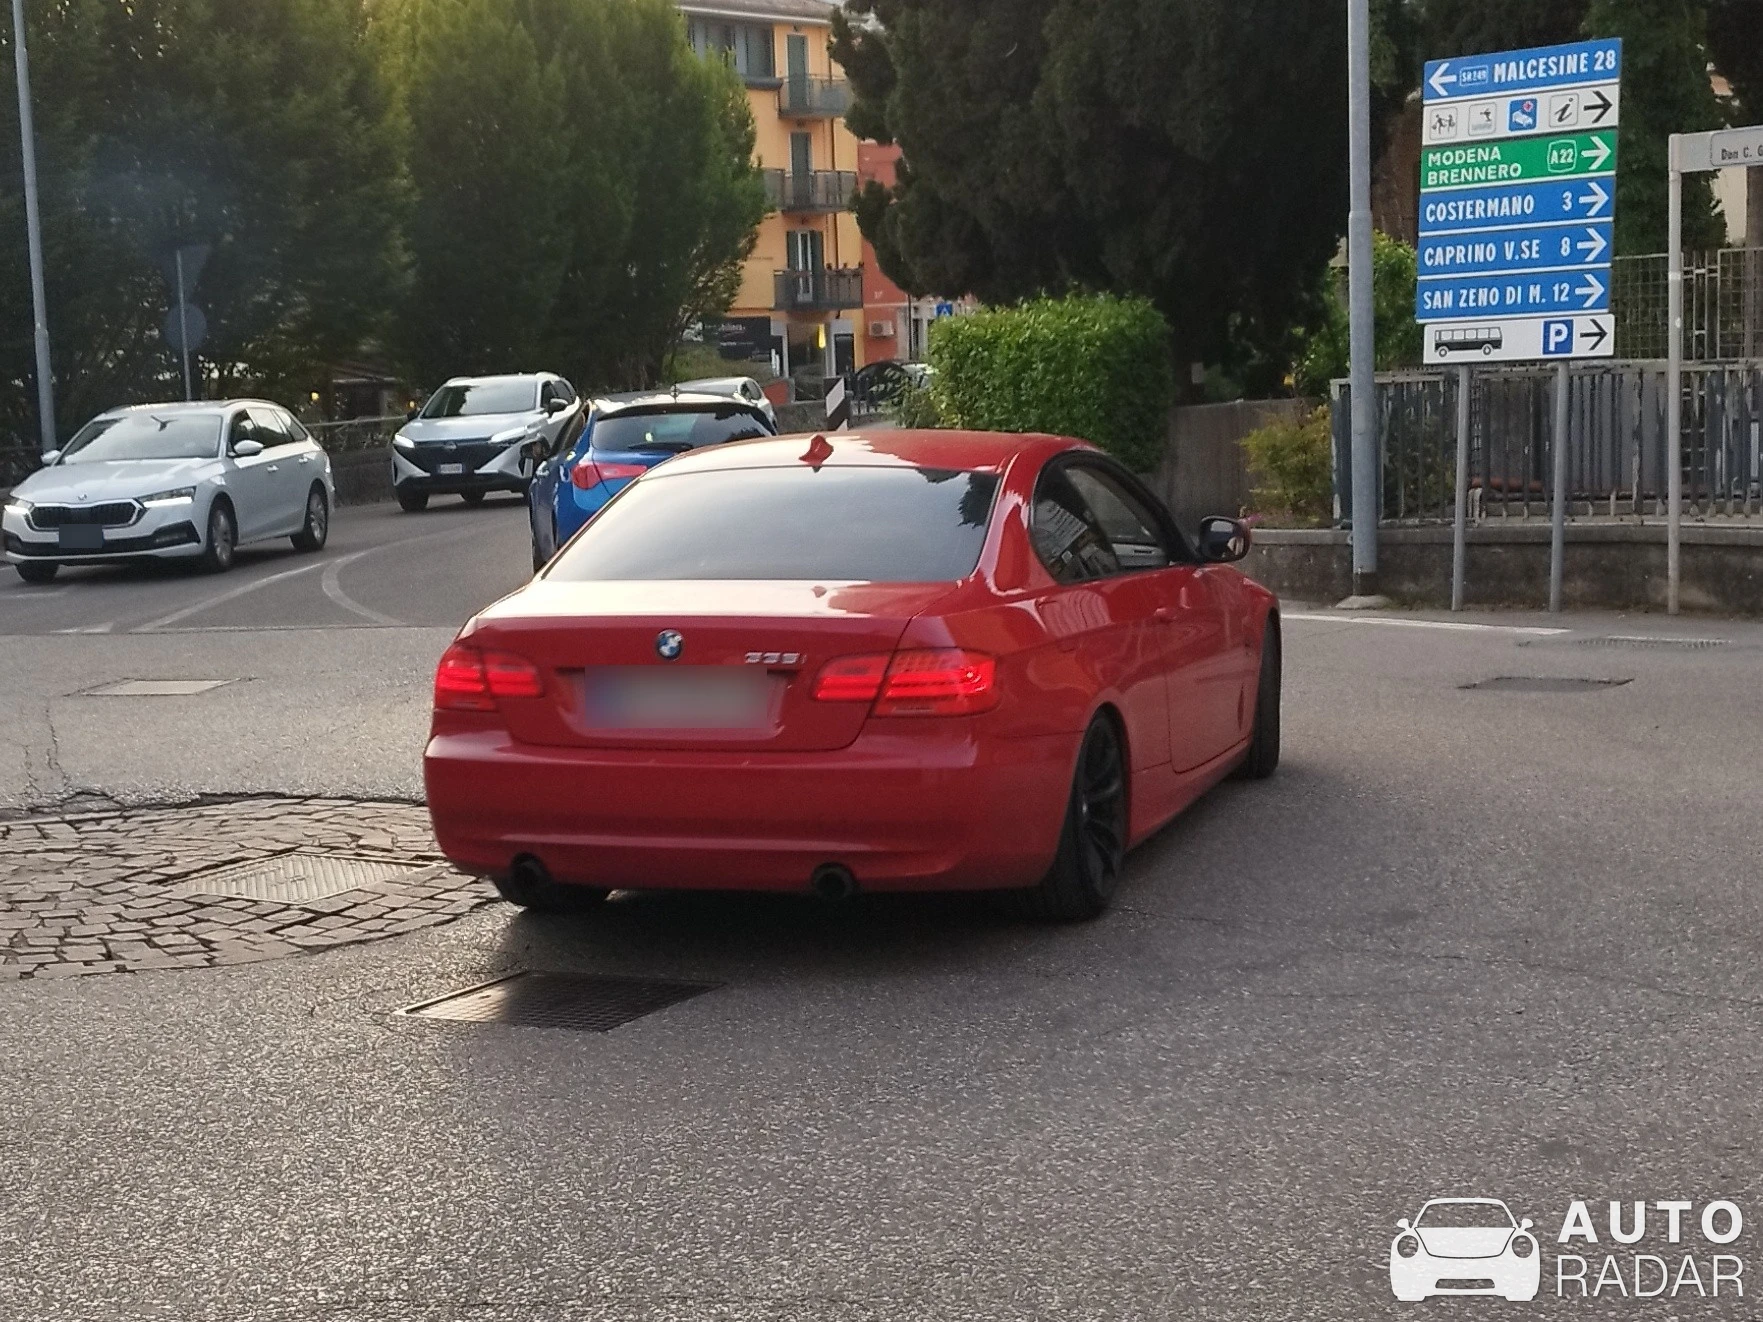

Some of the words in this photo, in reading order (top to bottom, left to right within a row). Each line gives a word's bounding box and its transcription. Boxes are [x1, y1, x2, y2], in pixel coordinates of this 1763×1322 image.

[1493, 53, 1588, 83] MALCESINE
[1594, 49, 1616, 71] 28
[1427, 146, 1501, 167] MODENA
[1550, 148, 1574, 165] A22
[1427, 163, 1522, 185] BRENNERO
[1425, 194, 1535, 223] COSTERMANO
[1562, 191, 1573, 211] 3
[1424, 242, 1496, 267] CAPRINO
[1504, 239, 1540, 261] V.SE
[1560, 236, 1571, 257] 8
[1423, 289, 1453, 310] SAN
[1459, 287, 1499, 308] ZENO
[1505, 285, 1521, 305] DI
[1529, 284, 1546, 303] M.
[1552, 282, 1570, 302] 12
[1549, 323, 1569, 351] P
